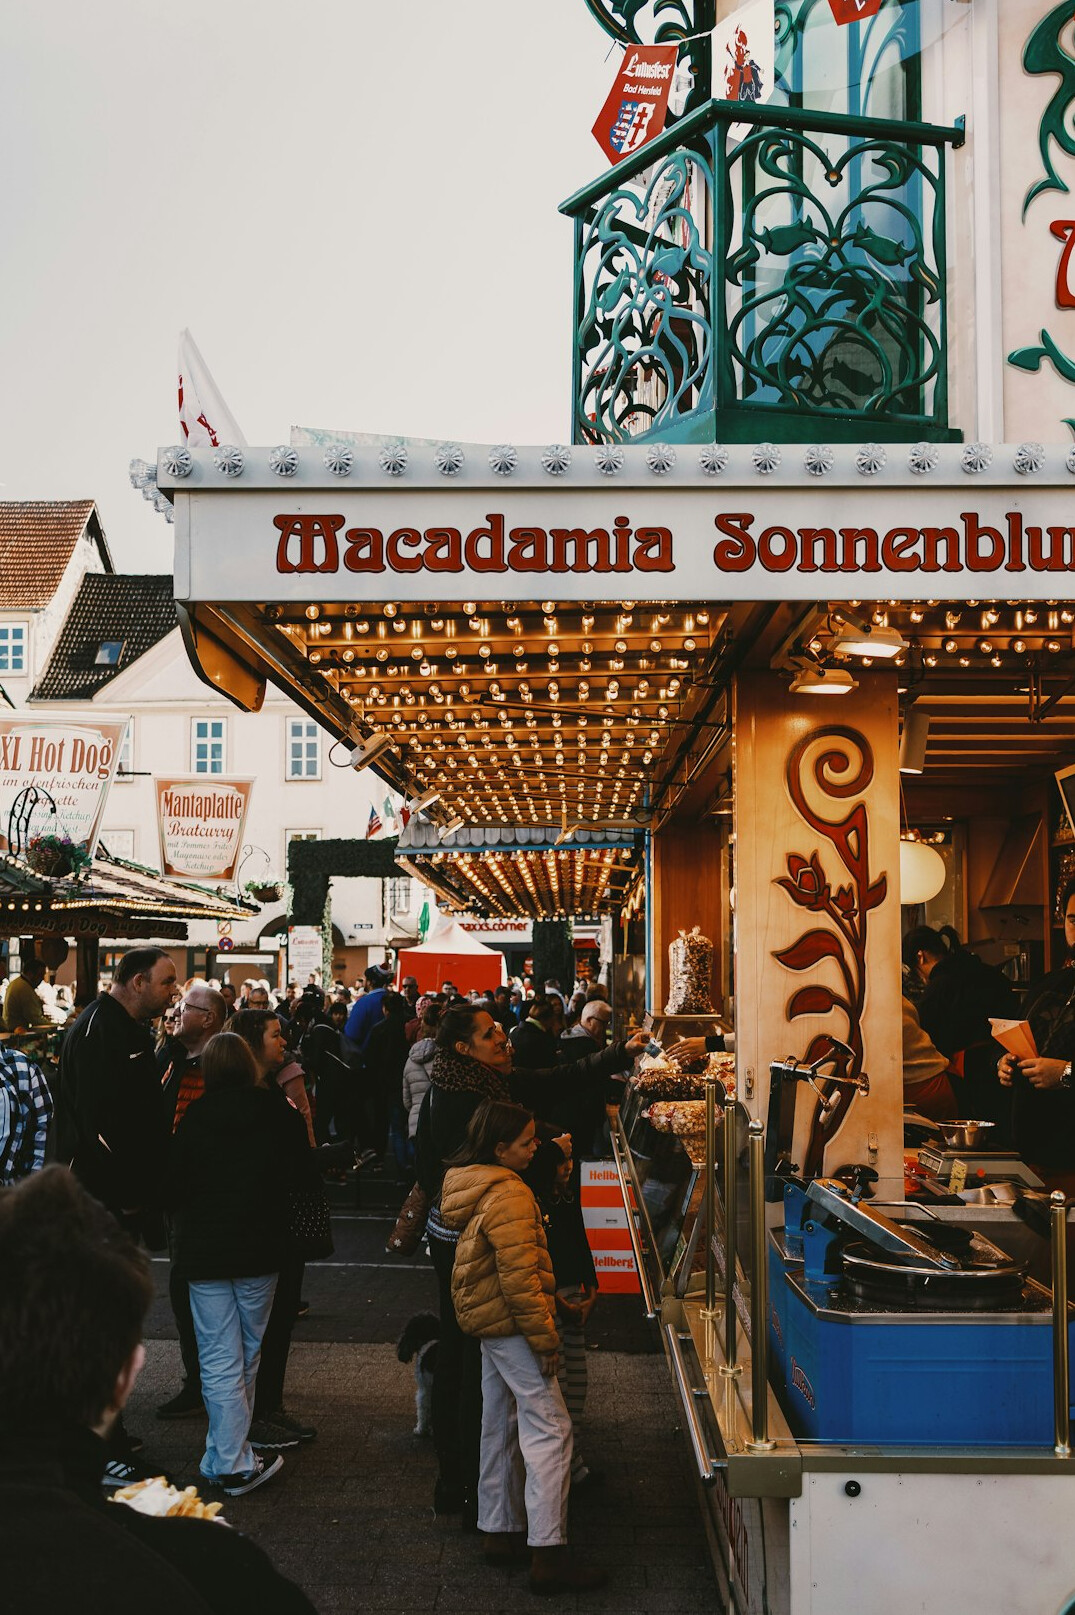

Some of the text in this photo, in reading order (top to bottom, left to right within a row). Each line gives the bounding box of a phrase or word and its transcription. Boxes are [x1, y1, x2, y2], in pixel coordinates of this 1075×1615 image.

[623, 83, 662, 96] Bad Hersfeld
[273, 512, 1075, 573] Macadamia Sonnenblu
[29, 737, 65, 772] Hot
[70, 738, 112, 779] Dog
[3, 776, 18, 786] im
[163, 791, 242, 822] Mantaplatte
[167, 820, 234, 842] Bratcurry
